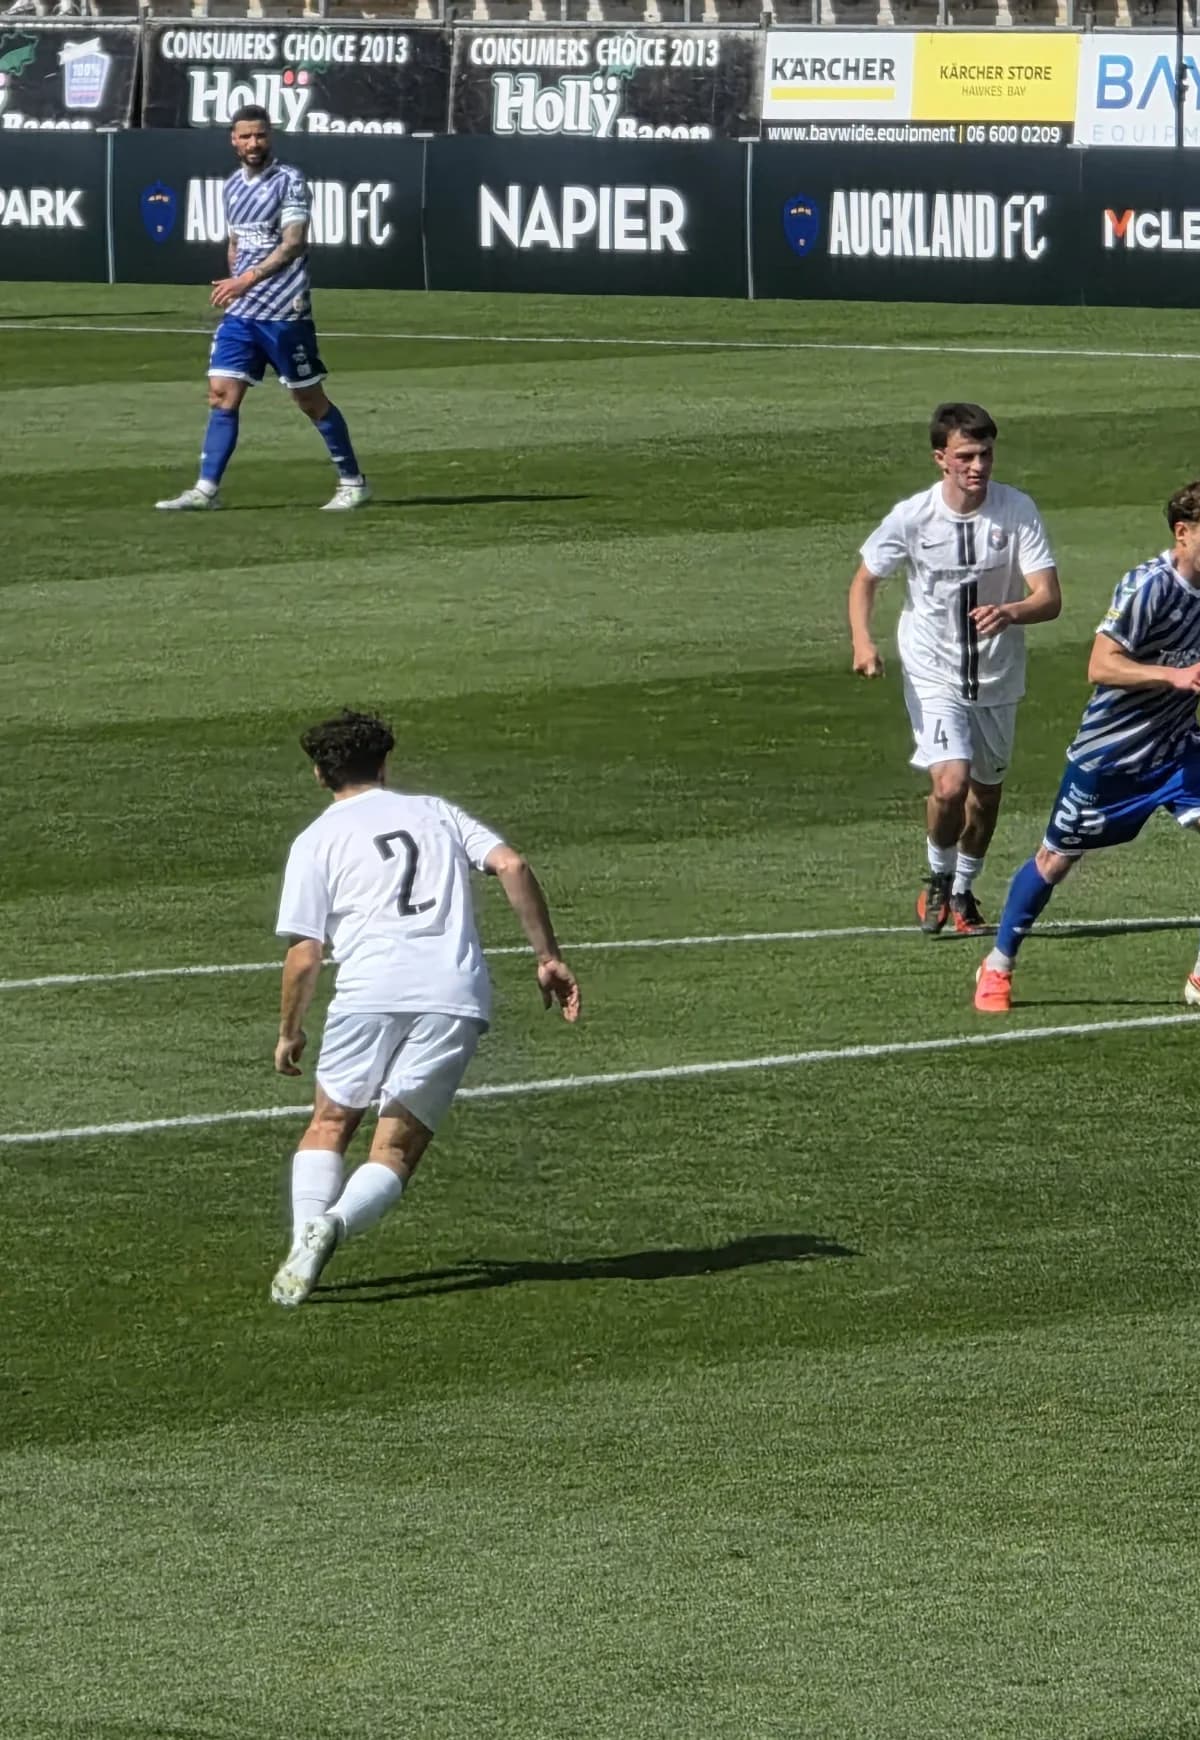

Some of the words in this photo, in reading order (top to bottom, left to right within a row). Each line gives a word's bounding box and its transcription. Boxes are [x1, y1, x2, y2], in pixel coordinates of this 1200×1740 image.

[162, 31, 276, 60] CONSUMERS
[284, 34, 356, 62] CHOICE
[360, 36, 409, 63] 2013
[470, 38, 588, 66] CONSUMERS
[596, 39, 666, 66] CHOICE
[670, 39, 719, 67] 2013
[771, 57, 895, 81] KÄRCHER
[940, 62, 1004, 80] KÄRCHER
[1007, 66, 1052, 80] STORE
[961, 86, 1002, 96] HAWKES
[1007, 86, 1026, 96] BAY
[967, 126, 984, 142] 06
[989, 126, 1017, 143] 600
[1021, 127, 1060, 143] 0209
[186, 178, 346, 243] AUND
[351, 182, 391, 245] FC
[480, 184, 688, 251] NAPIER
[828, 191, 998, 259] AUCKLAND
[1004, 195, 1046, 259] FC
[934, 719, 948, 749] 4
[373, 829, 437, 916] 2
